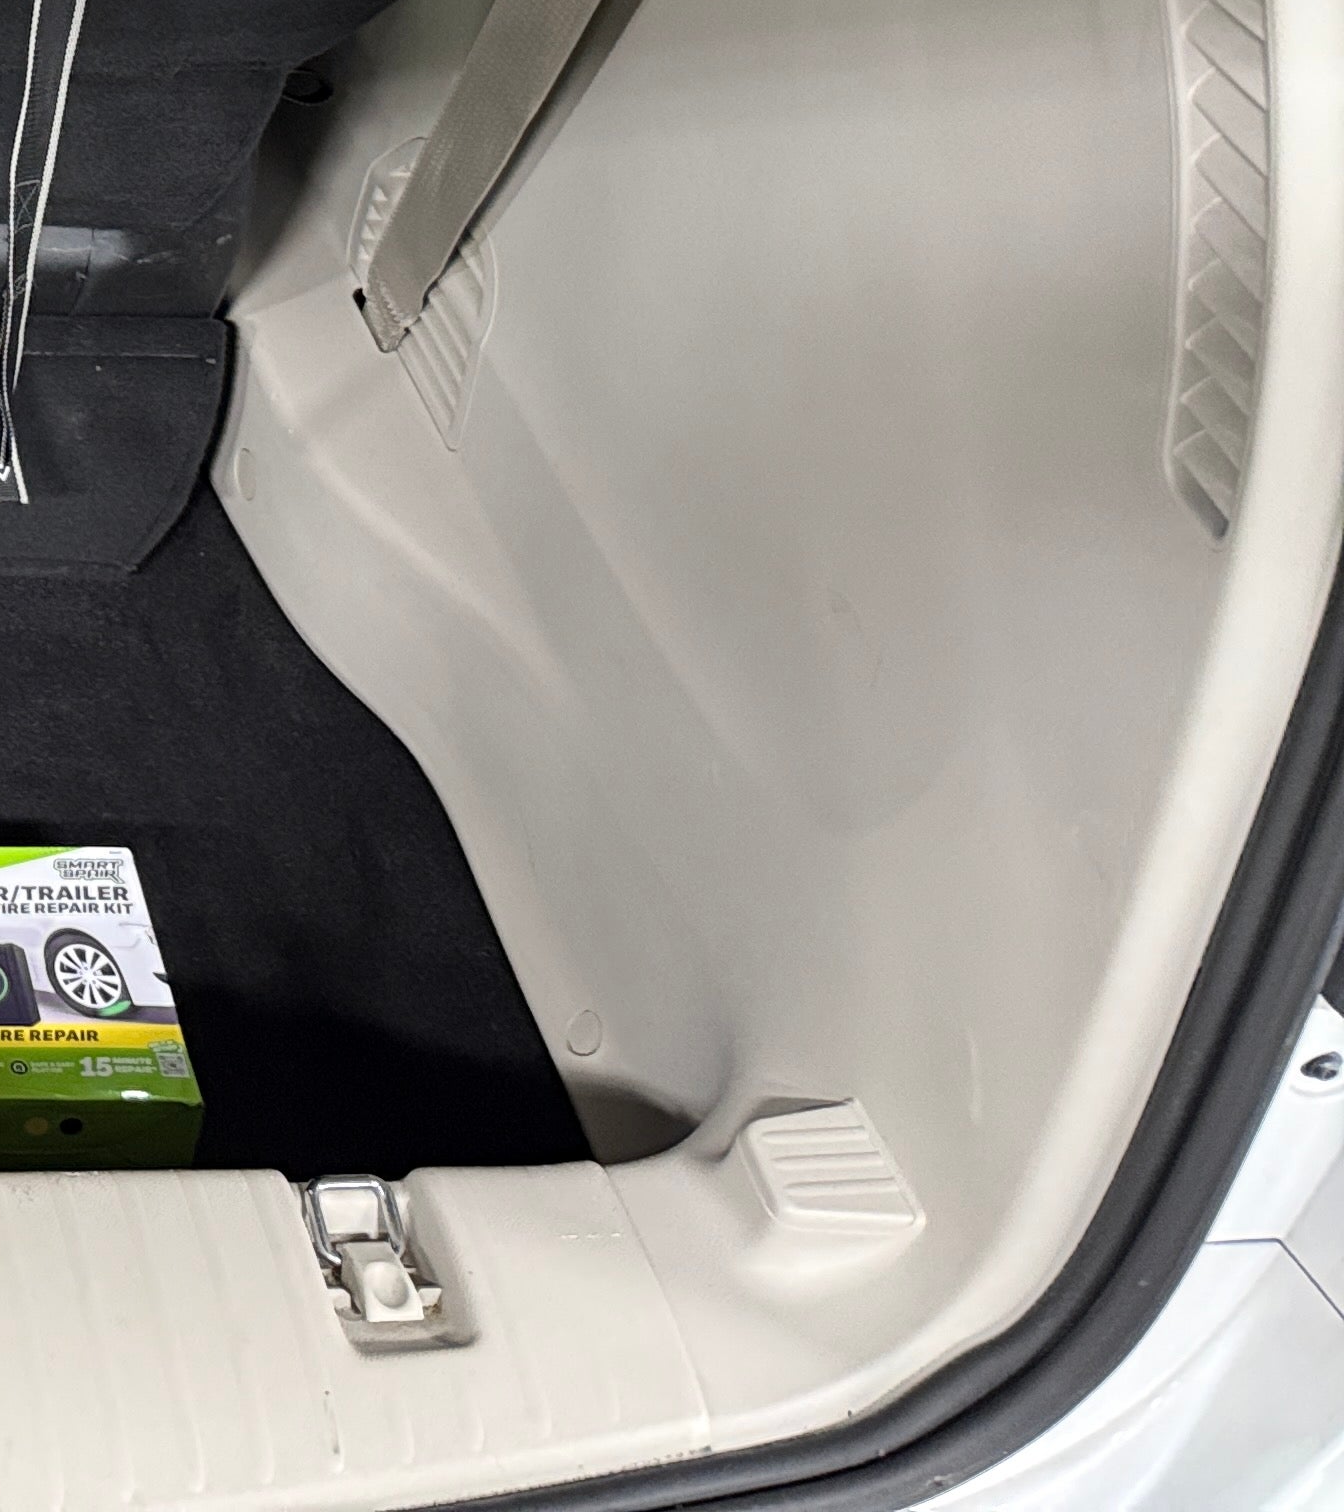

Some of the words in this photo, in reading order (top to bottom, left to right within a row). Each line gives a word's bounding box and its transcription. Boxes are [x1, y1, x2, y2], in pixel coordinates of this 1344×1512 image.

[56, 860, 119, 870] SMART
[34, 902, 100, 914] REPAIR
[104, 902, 134, 914] KIT
[29, 1029, 99, 1042] REPAIR
[79, 1056, 113, 1077] 15
